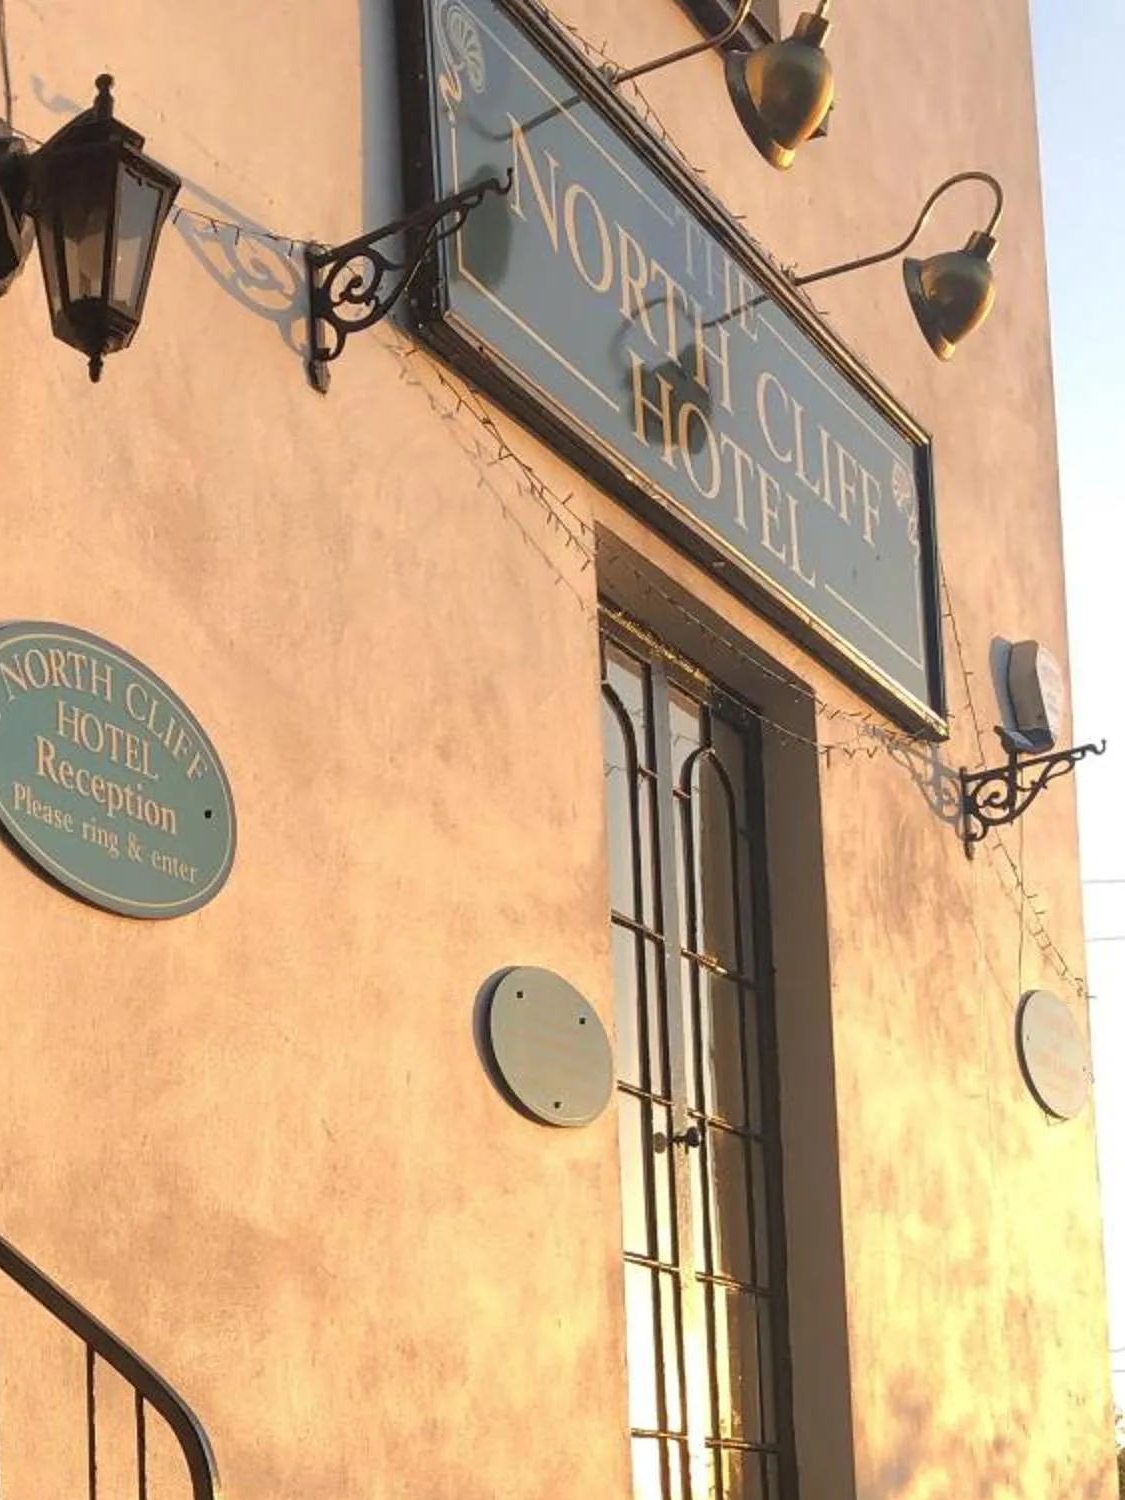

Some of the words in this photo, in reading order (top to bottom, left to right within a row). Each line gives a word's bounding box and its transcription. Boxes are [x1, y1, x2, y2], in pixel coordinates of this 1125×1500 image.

[675, 206, 759, 342] THE
[506, 112, 734, 416] NORTH
[756, 371, 882, 547] CLIFF
[628, 349, 816, 589] HOTEL
[56, 698, 159, 781] HOTEL
[126, 682, 209, 782] CLIFF
[13, 781, 75, 833] Please
[82, 816, 120, 858] ring
[127, 831, 145, 863] &
[151, 849, 199, 885] enter
[36, 735, 177, 836] Reception
